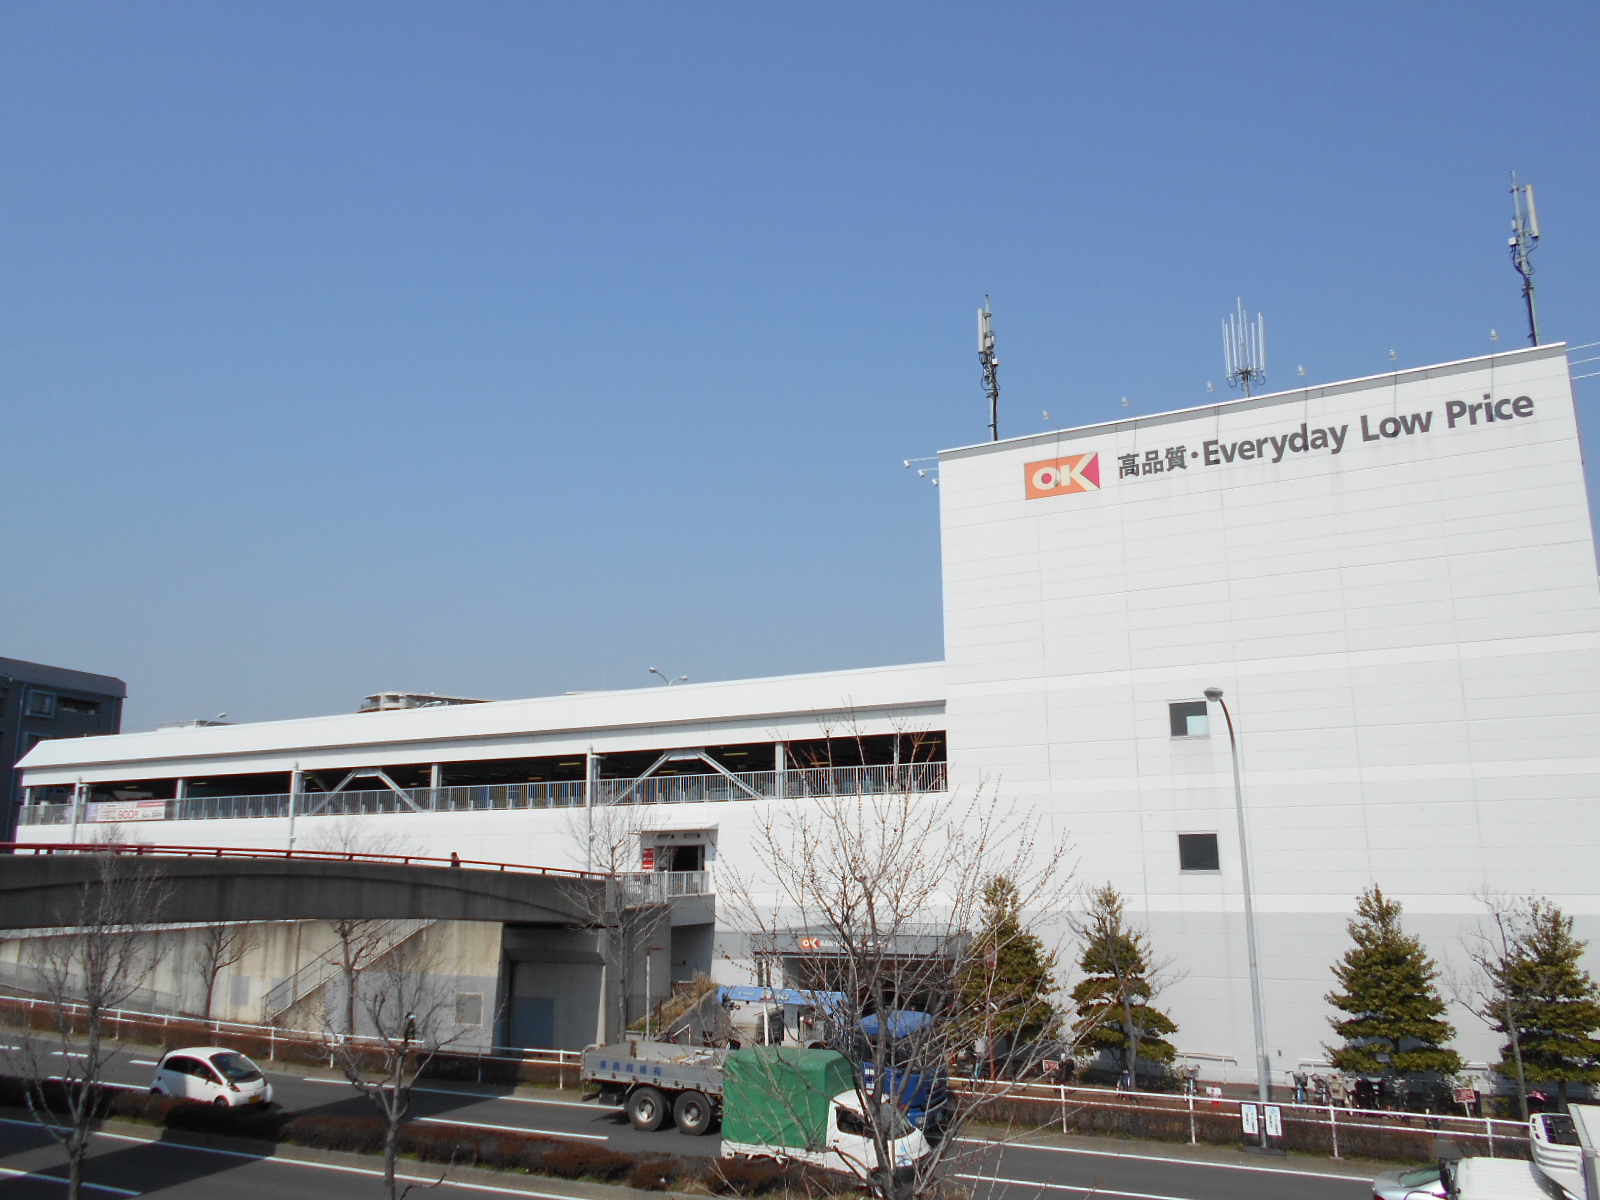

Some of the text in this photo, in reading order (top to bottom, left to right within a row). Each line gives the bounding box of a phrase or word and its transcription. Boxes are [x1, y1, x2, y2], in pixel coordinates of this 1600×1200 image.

[1359, 411, 1433, 442] Low
[1445, 393, 1534, 429] Price
[1031, 452, 1100, 491] OK
